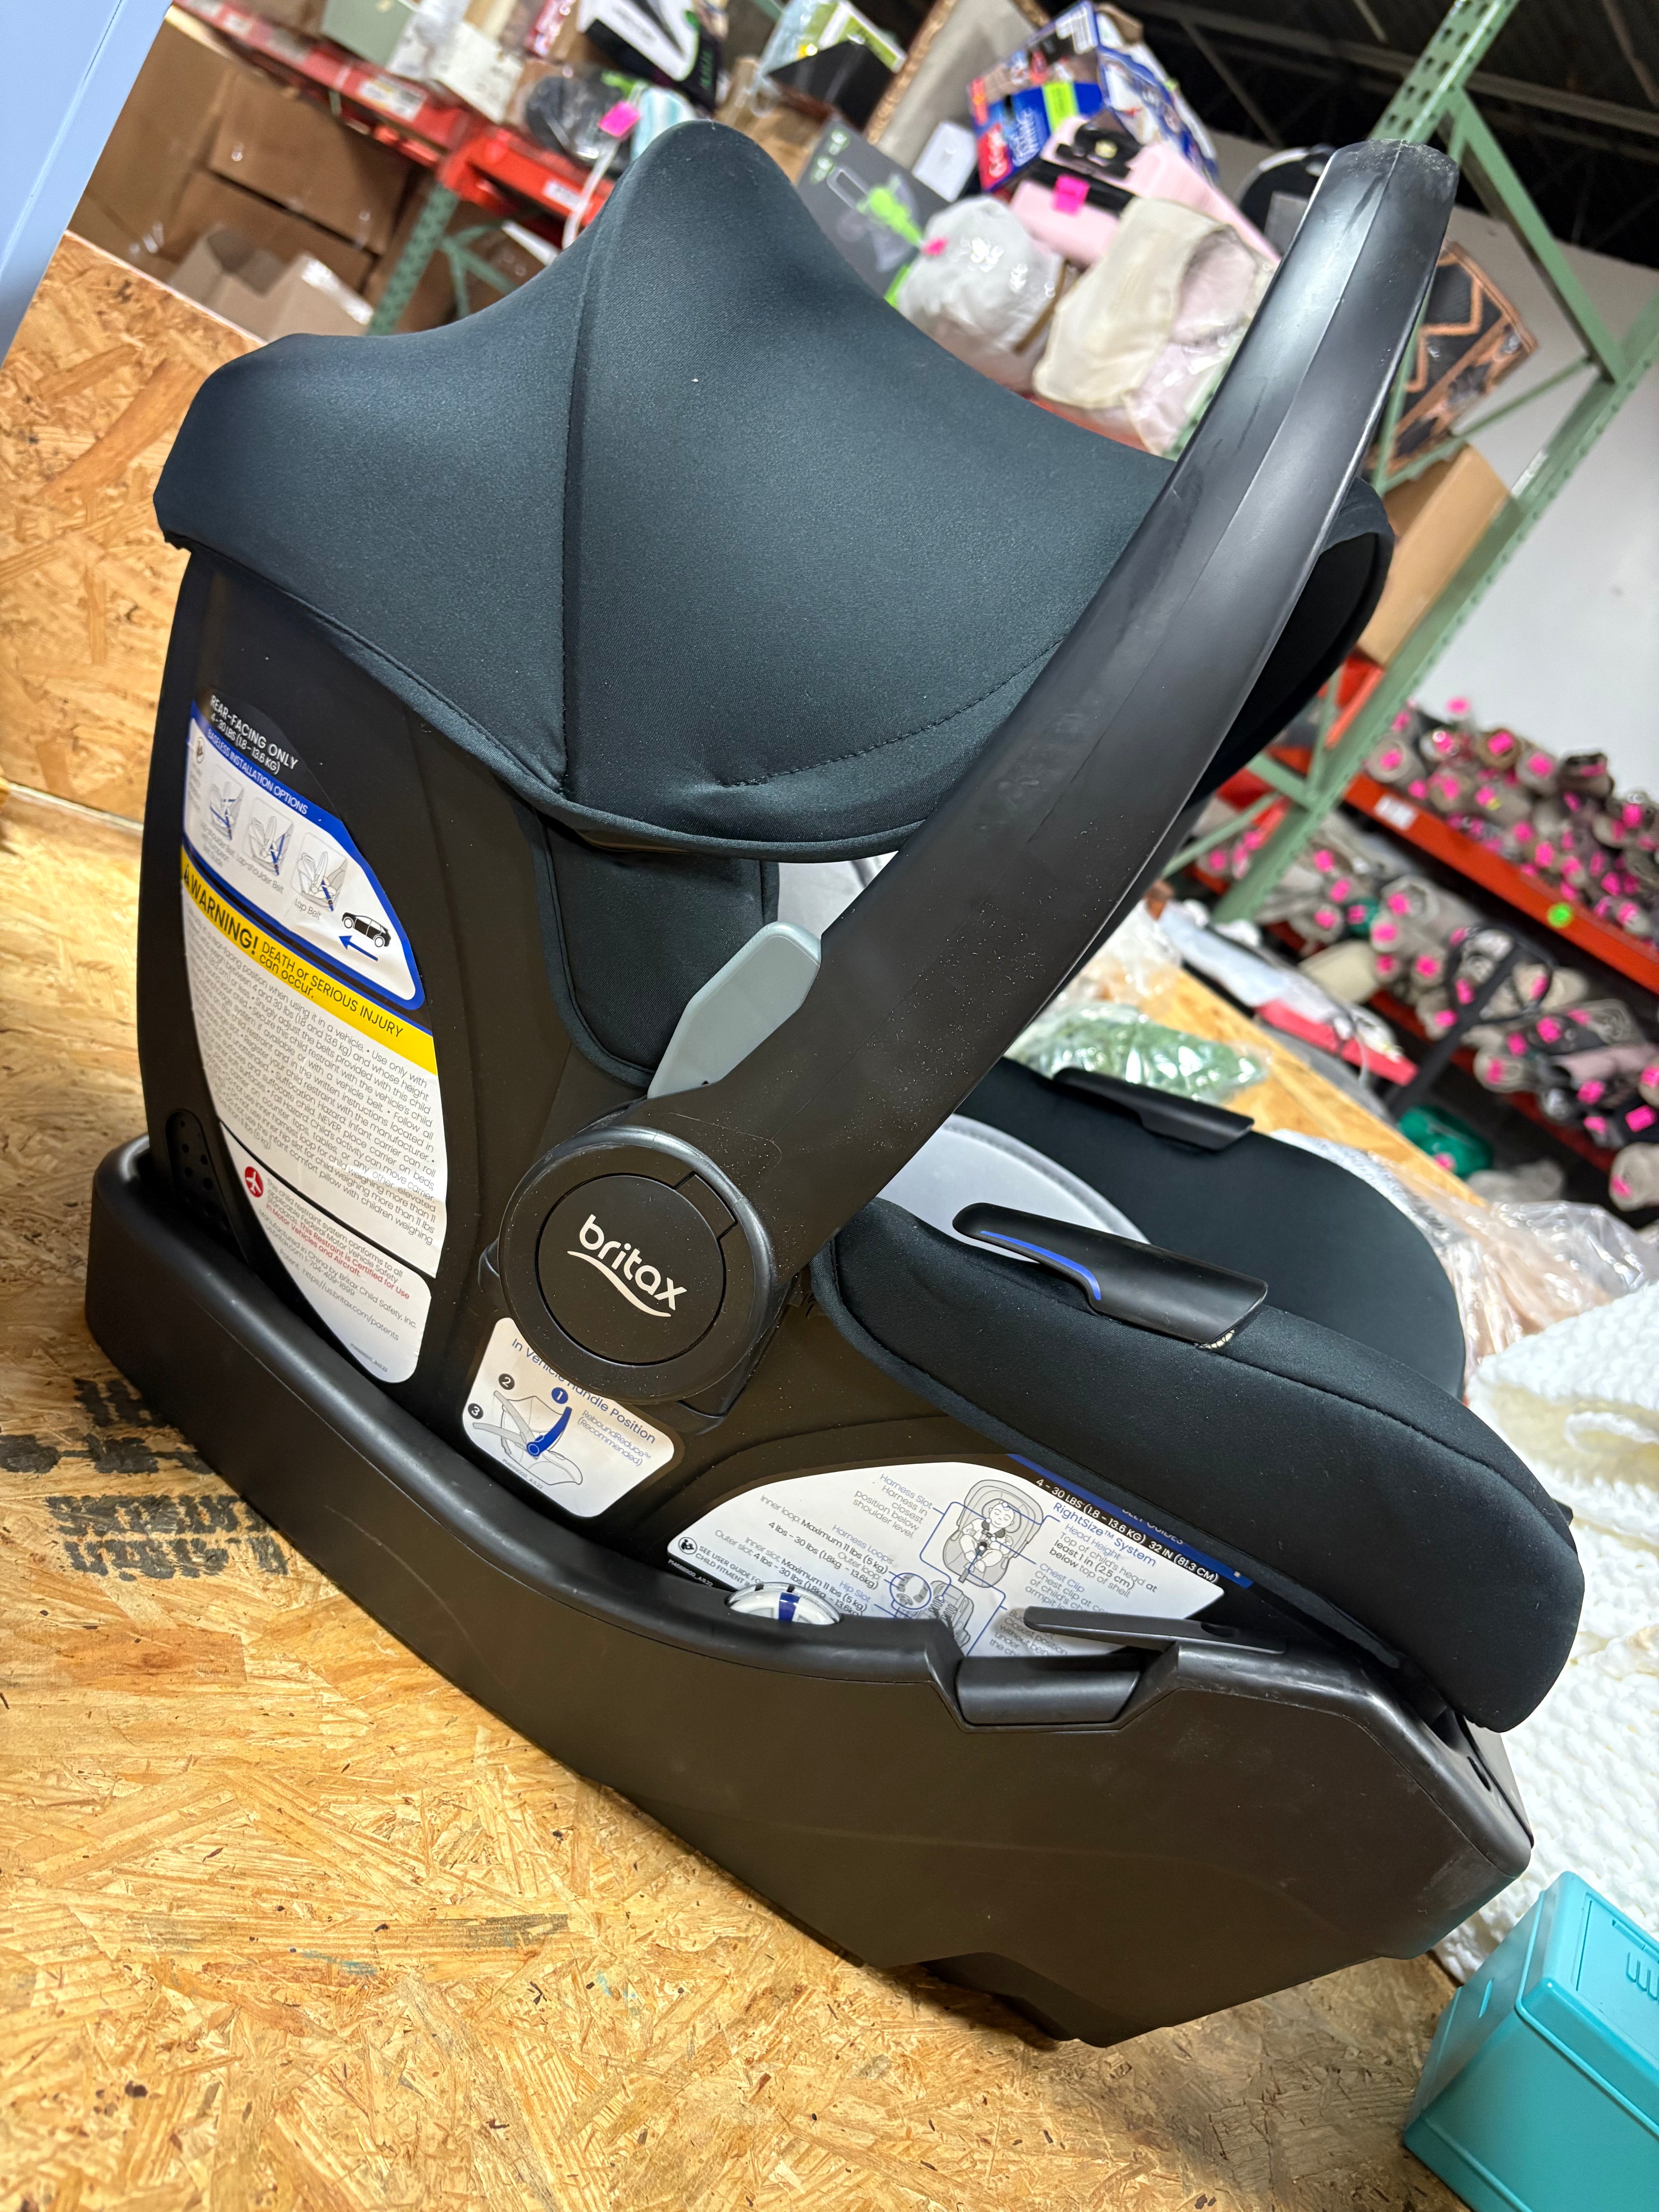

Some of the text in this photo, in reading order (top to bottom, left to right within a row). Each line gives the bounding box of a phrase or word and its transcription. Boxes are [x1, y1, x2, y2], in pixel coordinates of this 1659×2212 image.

[210, 695, 298, 769] REAR-FACING ONLY
[207, 728, 308, 814] BASELESS INSTALLATION OPTIONS
[251, 746, 265, 763] 13.6
[264, 757, 280, 775] KG)
[191, 874, 258, 955] WARNING!
[295, 898, 321, 920] Lap Belt
[259, 954, 314, 998] can occur.
[261, 941, 404, 1037] DEATH or SERIOUS INJURY
[335, 1054, 431, 1115] provided with this child
[352, 1053, 429, 1102] and whose height
[371, 1050, 387, 1065] Use
[389, 1062, 408, 1078] only
[409, 1073, 427, 1088] with
[314, 1075, 424, 1147] written instructions located
[336, 1078, 364, 1100] vehicle
[393, 1111, 421, 1132] Follow
[422, 1130, 434, 1140] all
[341, 1069, 433, 1128] with the vehicle's child
[342, 1130, 434, 1191] place carrier on beds,
[348, 1120, 436, 1178] Infant carrier can roll
[369, 1123, 429, 1163] manufacturer.
[364, 1155, 437, 1204] can move carrier.
[372, 1171, 436, 1212] other elevated
[361, 1197, 433, 1246] children weighing
[385, 1189, 436, 1223] more than 11
[300, 1221, 410, 1299] This Restraint is Certified for Use
[322, 1222, 403, 1278] system conforms to all
[326, 1233, 398, 1284] Motor Vehicle Safety
[579, 1214, 687, 1311] britax
[307, 1250, 328, 1270] China
[328, 1265, 338, 1279] by
[338, 1273, 359, 1290] Britax
[359, 1286, 378, 1304] Child
[378, 1299, 403, 1321] Safety,
[502, 1376, 511, 1388] 2
[512, 1338, 523, 1352] In
[609, 1407, 655, 1444] Position
[471, 1406, 480, 1416] 3
[577, 1416, 643, 1467] (Recommended)
[854, 1490, 919, 1531] position below
[879, 1473, 933, 1509] Harness Slot
[881, 1484, 927, 1516] Harness in
[891, 1502, 924, 1524] closest
[760, 1494, 781, 1510] Inner
[800, 1519, 843, 1547] Maximum
[843, 1543, 850, 1551] 11
[849, 1547, 862, 1559] lbs
[862, 1554, 873, 1565] (5
[872, 1561, 888, 1575] kg)
[852, 1499, 914, 1539] shoulder level.
[1051, 1486, 1065, 1498] 30
[1108, 1518, 1127, 1533] 13.6
[1124, 1528, 1146, 1546] KG)
[1148, 1540, 1162, 1553] 32
[1161, 1548, 1173, 1559] IN
[1171, 1554, 1197, 1574] (81.3
[1196, 1567, 1218, 1583] CM)
[1064, 1523, 1121, 1560] Head Height
[698, 1546, 712, 1556] SEE
[711, 1553, 730, 1566] USER
[729, 1563, 751, 1579] GUIDE
[775, 1524, 788, 1536] lbs
[793, 1536, 806, 1546] 30
[805, 1542, 819, 1554] lbs
[850, 1568, 879, 1590] 13.6kg)
[832, 1524, 894, 1564] Harness Loops
[1049, 1547, 1079, 1568] below
[1079, 1565, 1096, 1578] top
[1096, 1576, 1108, 1584] of
[1054, 1539, 1079, 1558] least
[1083, 1556, 1093, 1567] in
[1094, 1562, 1114, 1578] (2.5
[1113, 1575, 1135, 1590] cm)
[1060, 1531, 1158, 1592] Top of child's head at
[1114, 1537, 1156, 1567] System
[744, 1536, 766, 1552] Inner
[780, 1558, 823, 1586] Maximum
[823, 1582, 830, 1590] 11
[828, 1585, 842, 1597] lbs
[842, 1593, 853, 1603] (5
[852, 1599, 867, 1614] kg)
[839, 1580, 871, 1603] Hip Slot
[1039, 1563, 1085, 1593] Chest Clip
